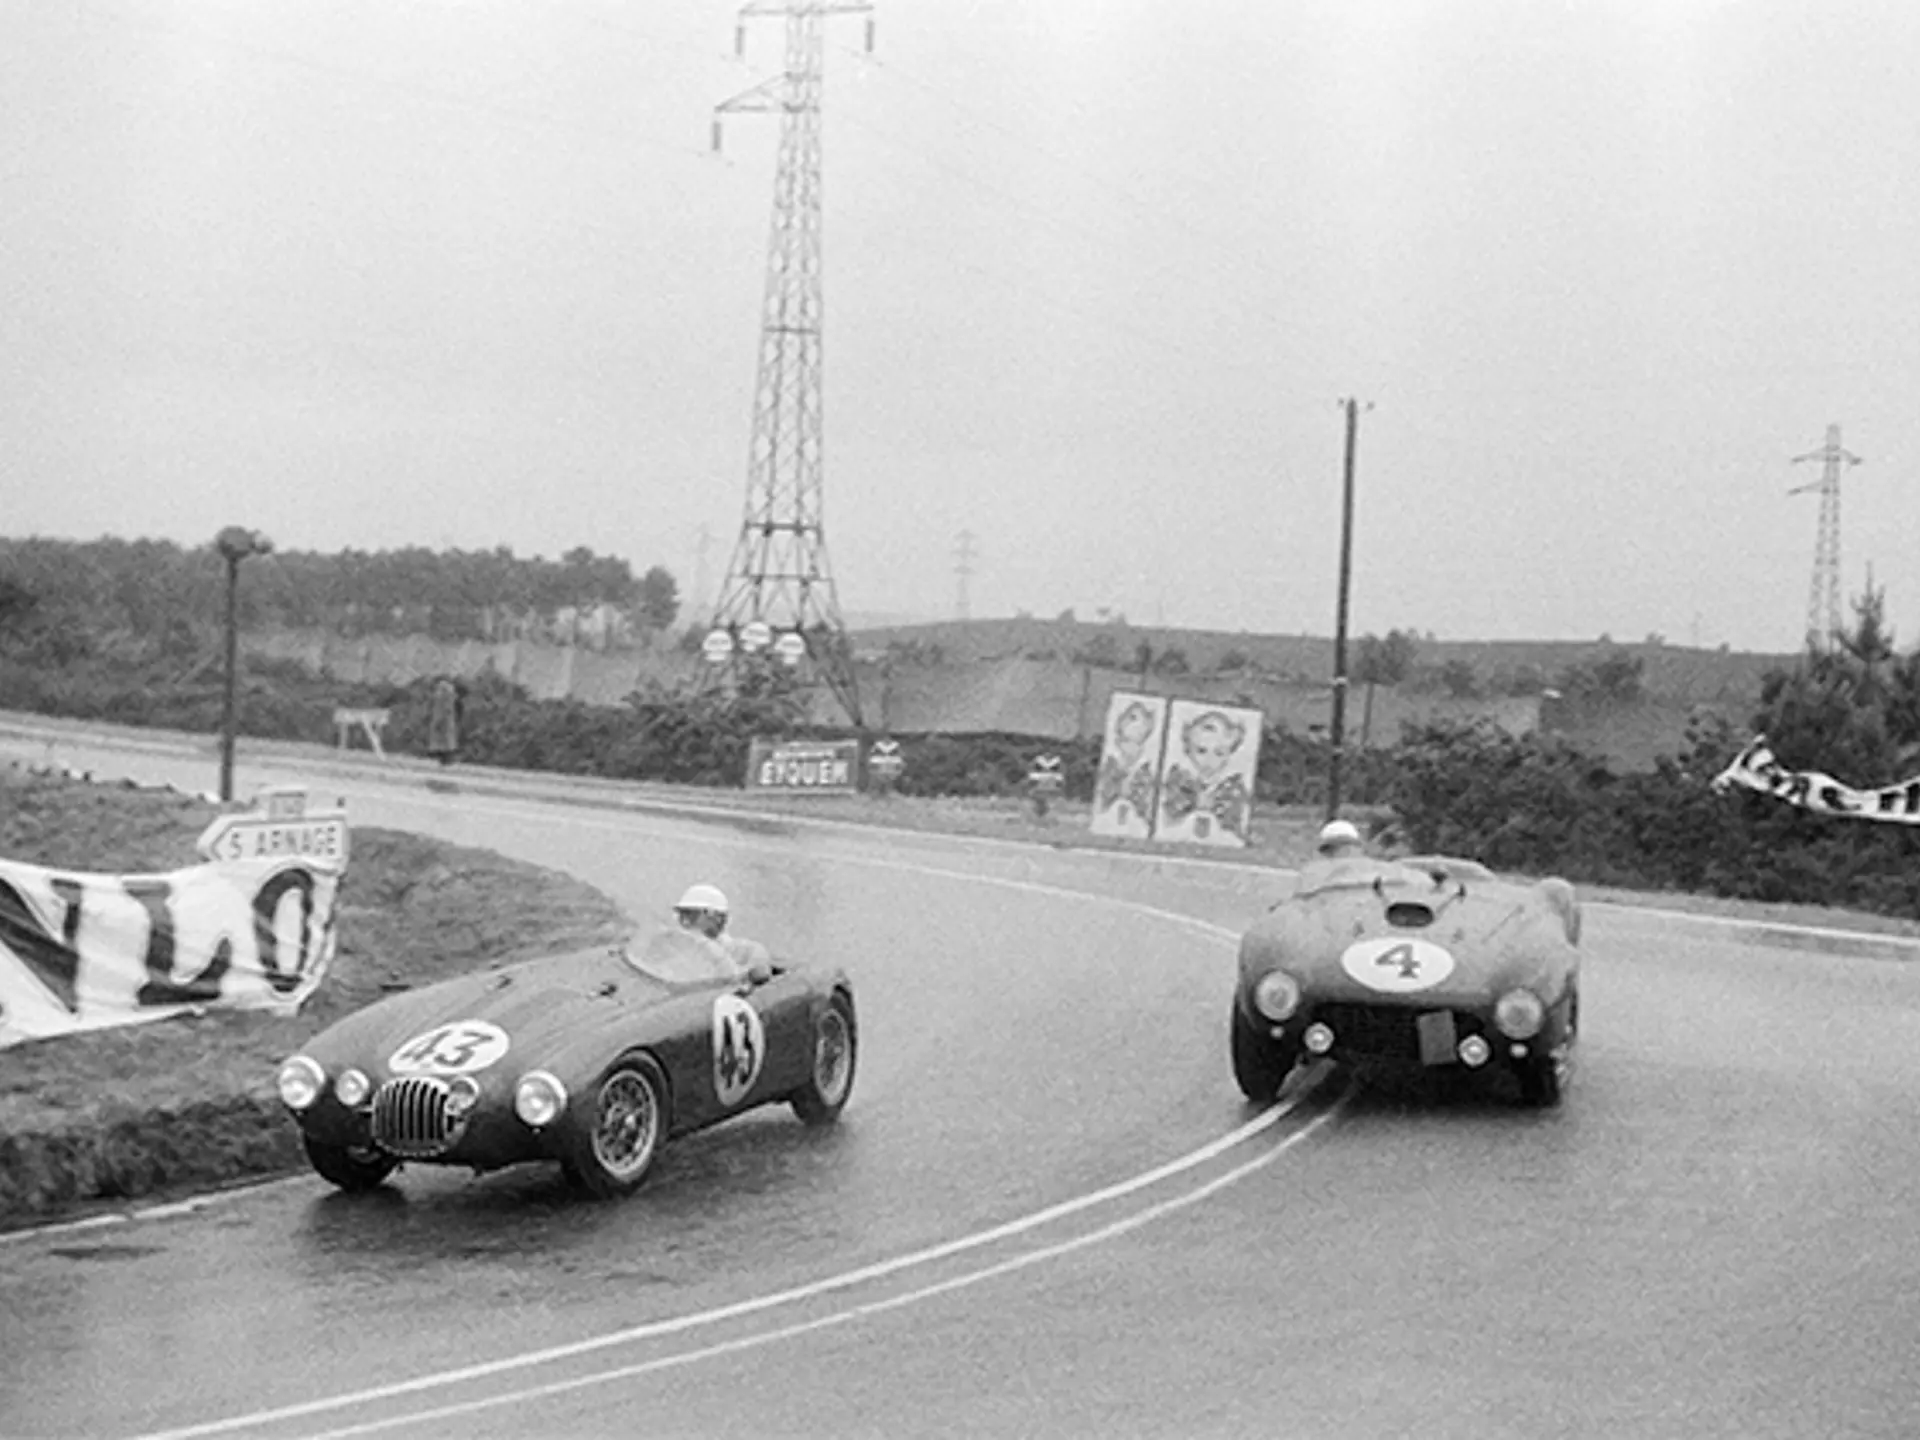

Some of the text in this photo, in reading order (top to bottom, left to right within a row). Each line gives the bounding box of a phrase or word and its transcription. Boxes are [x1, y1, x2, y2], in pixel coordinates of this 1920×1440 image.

[255, 826, 337, 857] ARNAGE
[1374, 942, 1423, 980] 4
[399, 1029, 496, 1067] 43
[719, 1011, 757, 1089] 43
